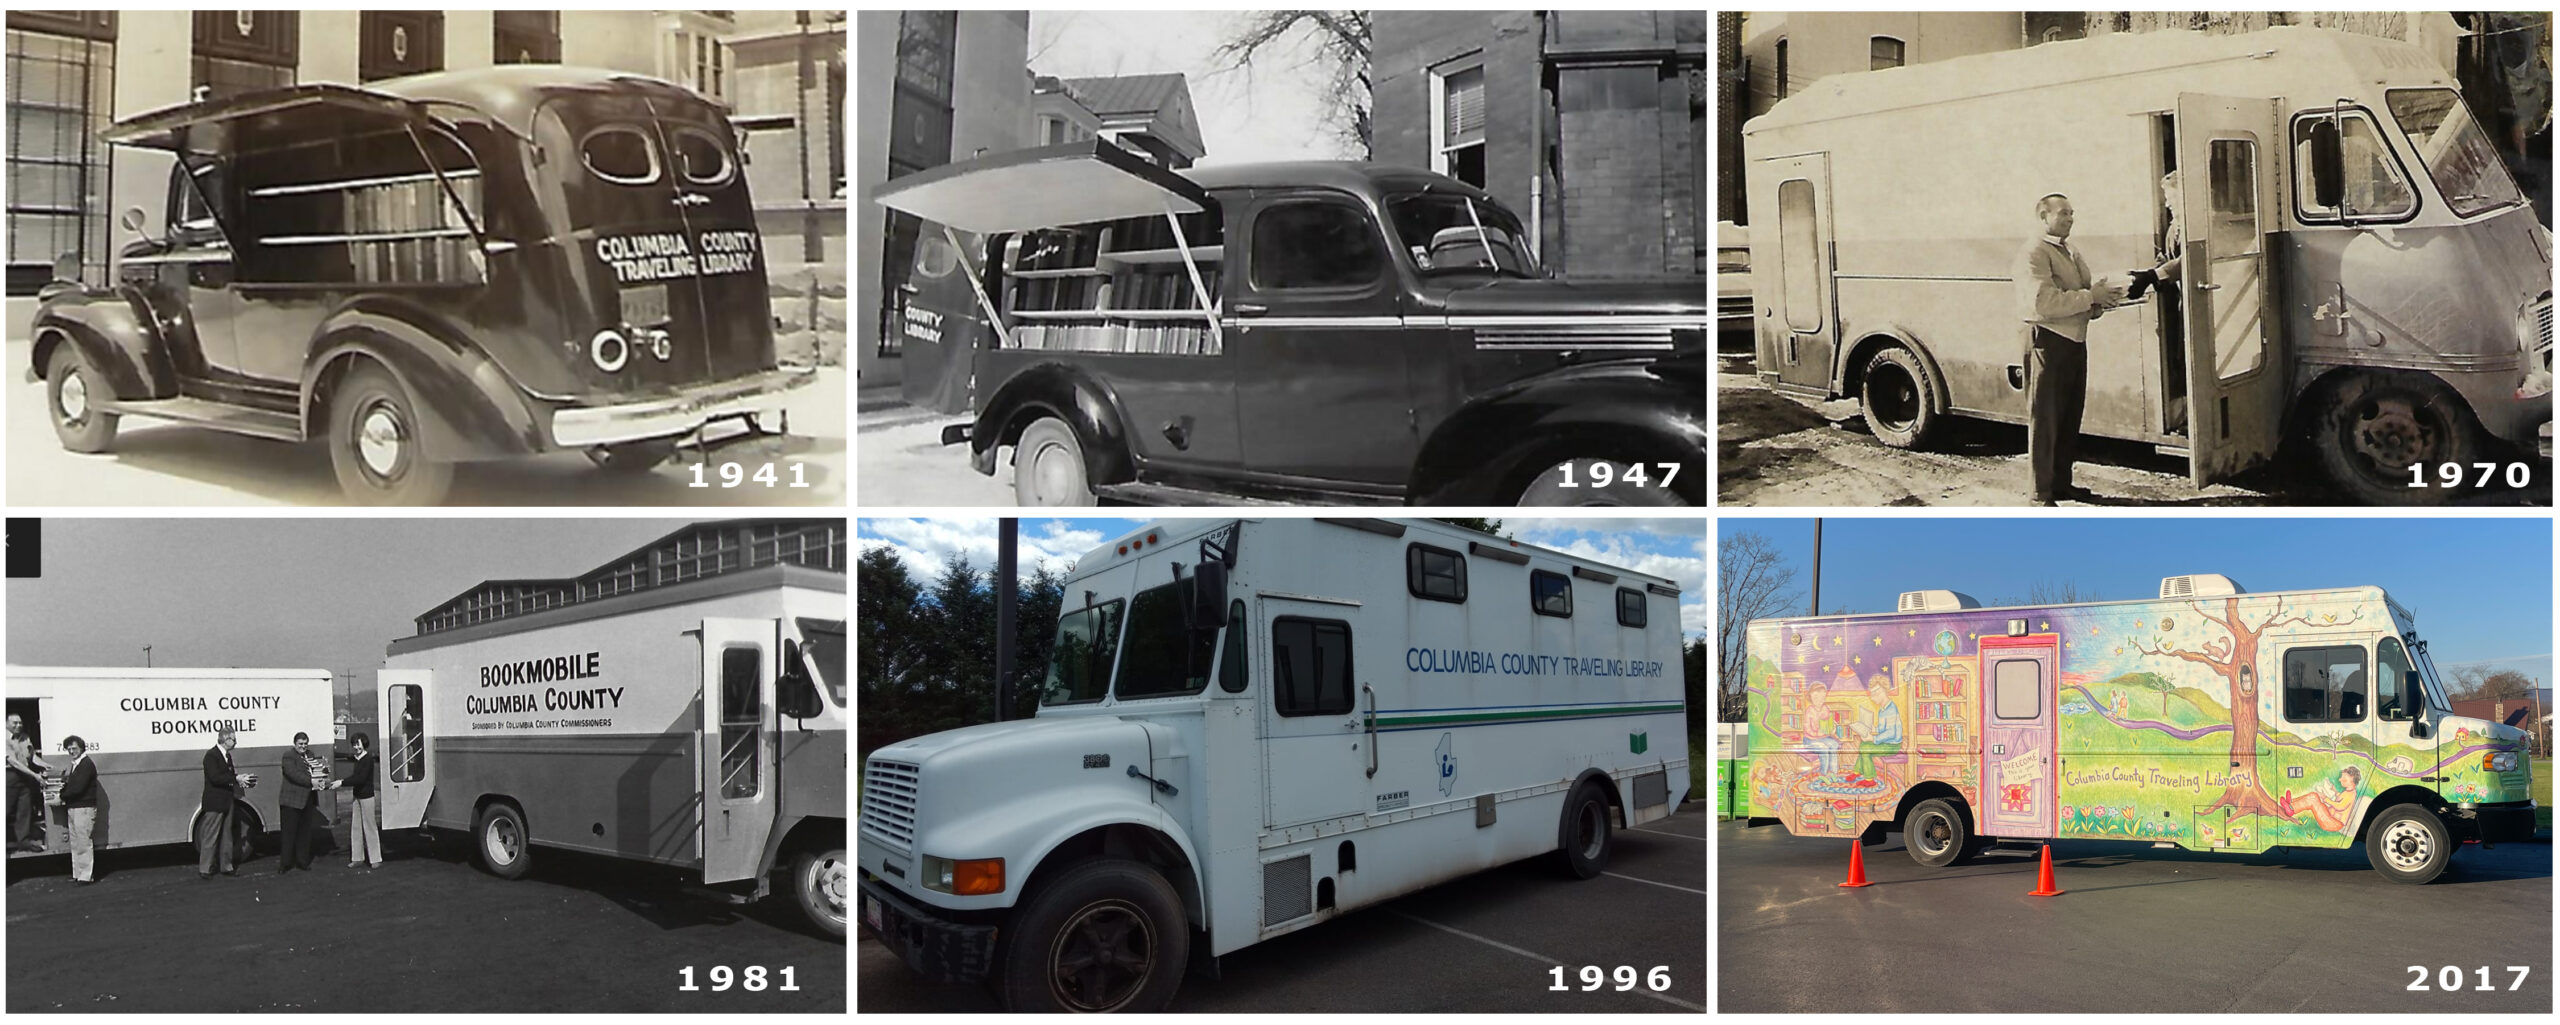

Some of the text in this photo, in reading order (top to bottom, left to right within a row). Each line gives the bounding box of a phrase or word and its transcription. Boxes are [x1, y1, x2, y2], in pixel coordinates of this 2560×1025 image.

[597, 231, 757, 261] COLUMBIA COUNTY
[612, 252, 754, 282] TRAVELING LIBRARY
[905, 305, 943, 328] COUNTY
[904, 321, 942, 344] LIBRARY
[480, 651, 600, 688] BOOKMOBILE
[1406, 647, 1664, 678] COLUMBIA COUNTY TRAVELING LIBRARY
[119, 696, 281, 712] COLUMBIA COUNTY
[466, 686, 625, 715] COLUMBIA COUNTY
[506, 720, 534, 729] COLUMBIA
[535, 719, 560, 729] COUNTY
[560, 718, 612, 728] COMMISSIONERS
[2002, 752, 2038, 770] WELCOME
[2066, 766, 2253, 793] Columbia County Traveling Library
